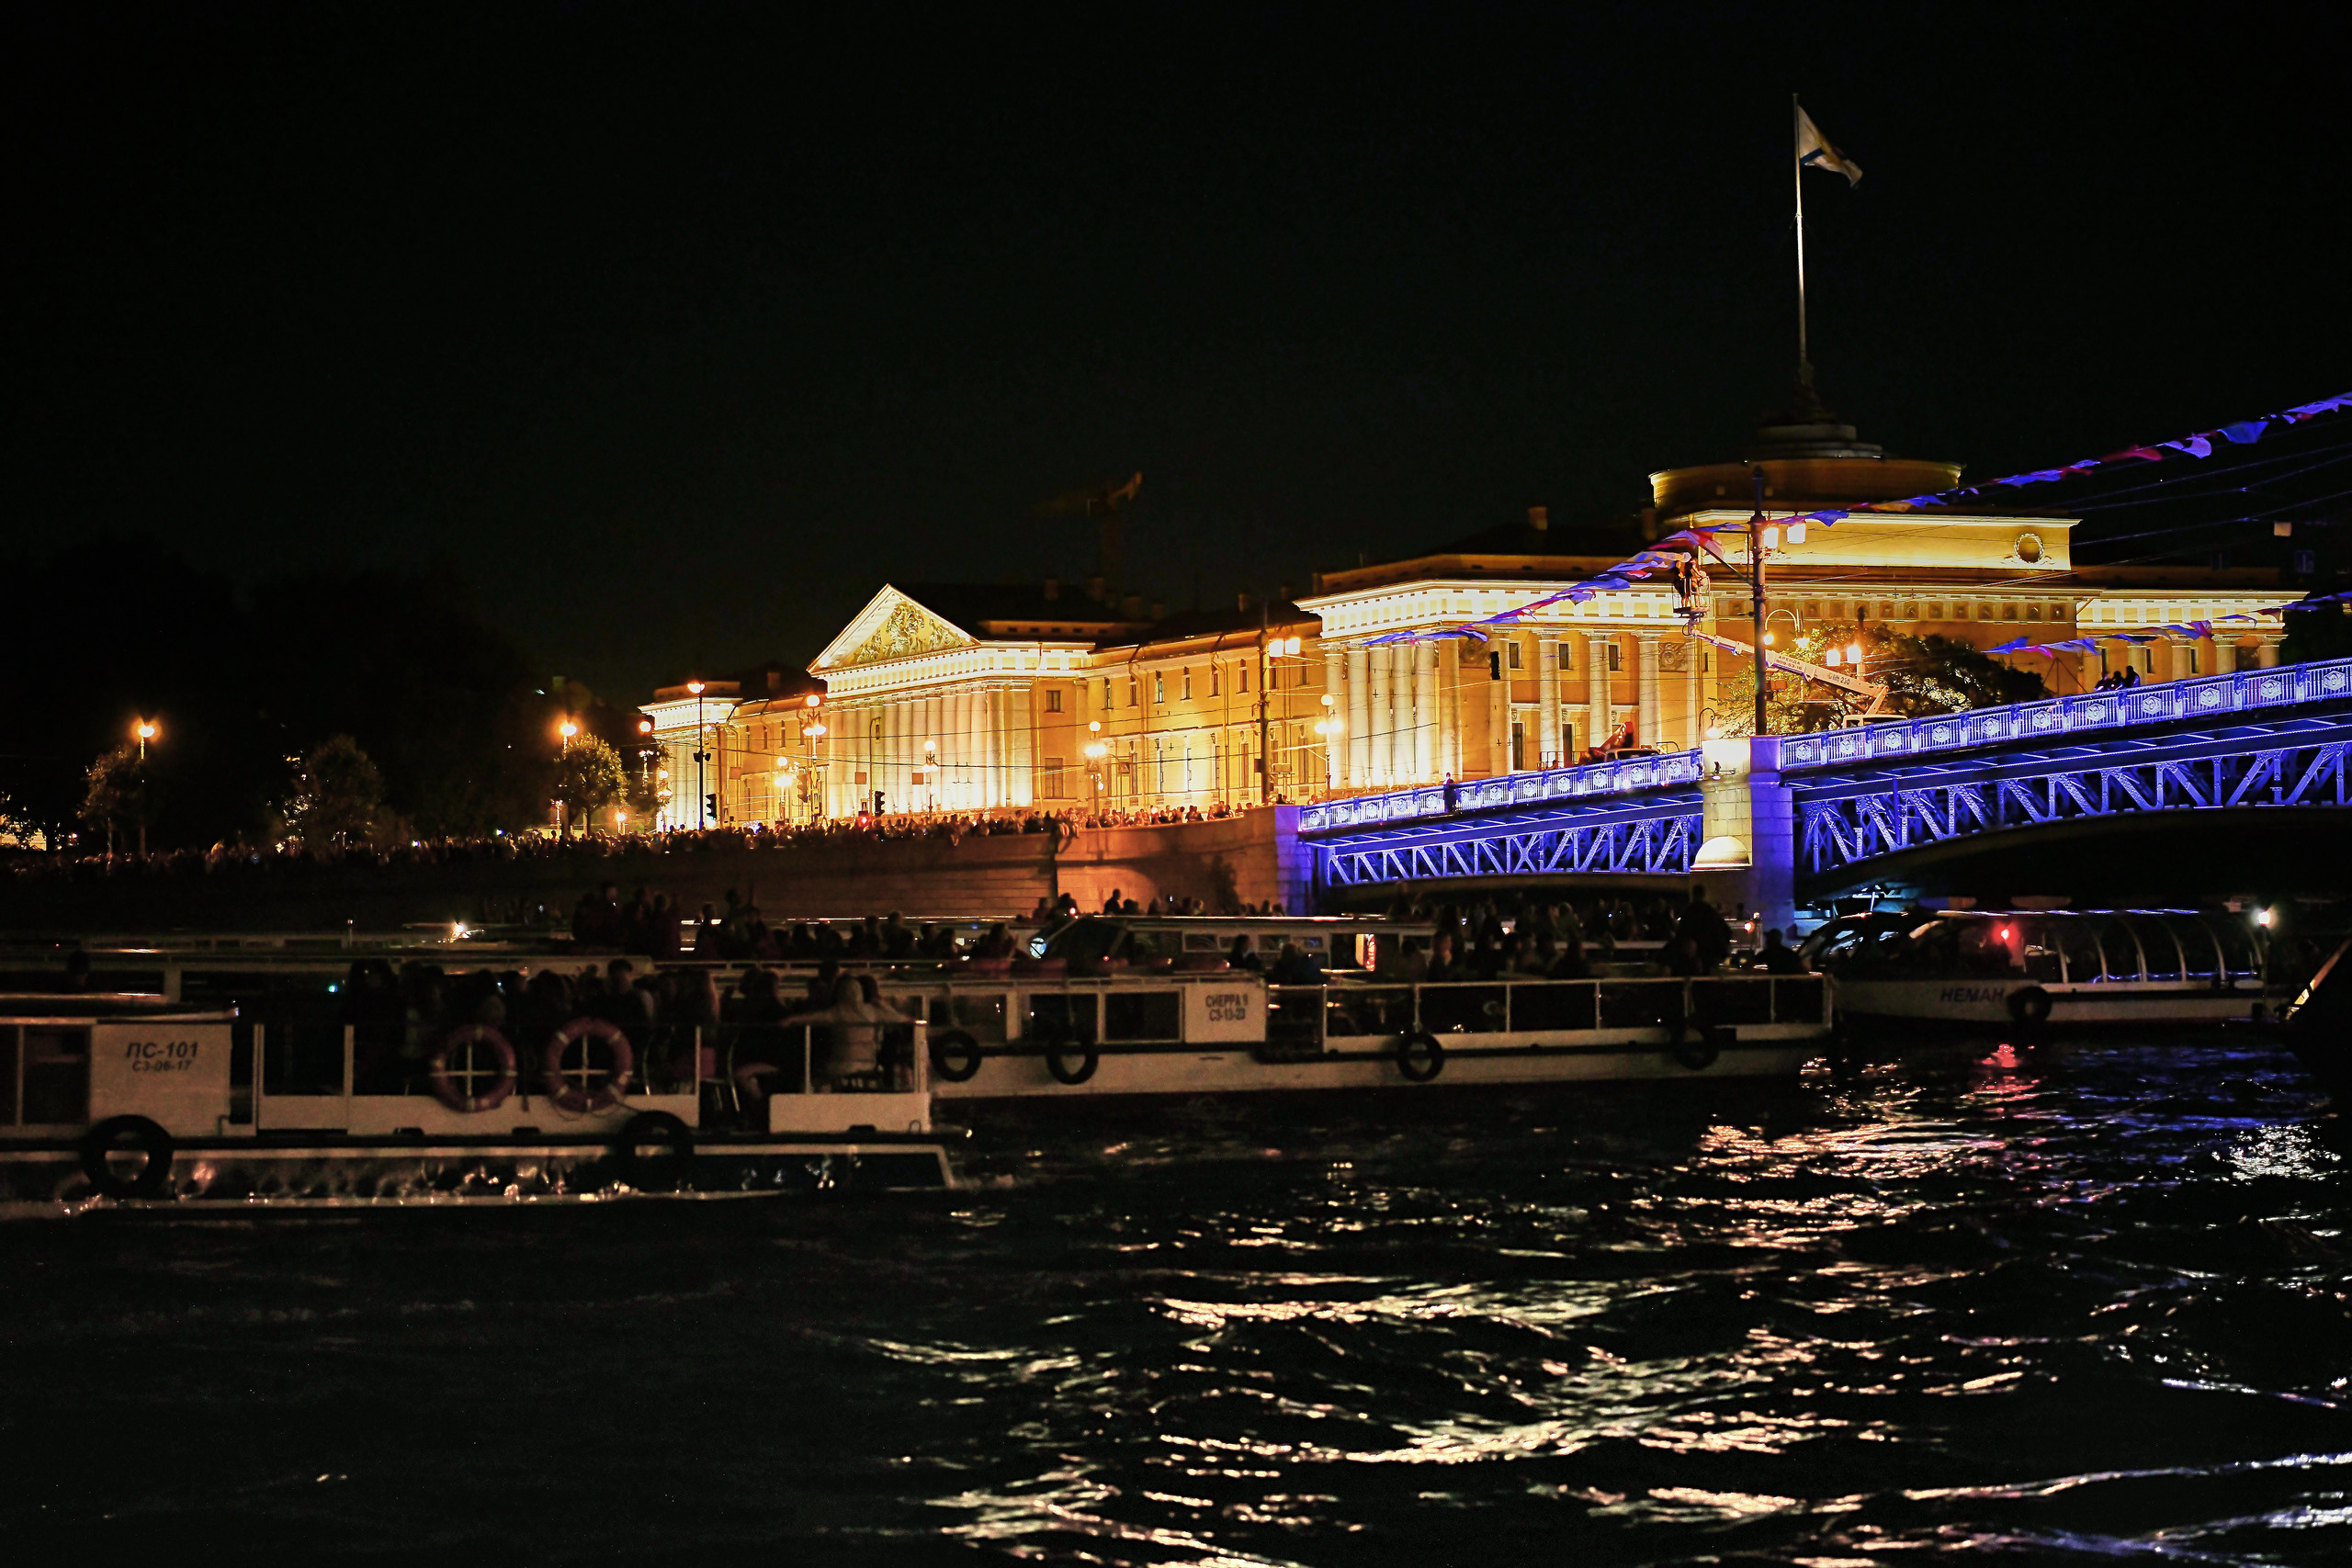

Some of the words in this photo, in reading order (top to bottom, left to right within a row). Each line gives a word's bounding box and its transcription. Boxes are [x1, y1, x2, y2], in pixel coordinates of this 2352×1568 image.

[1779, 655, 1801, 665] АРЕНДА
[1940, 987, 2004, 1002] НЕМАН
[126, 1042, 198, 1058] ПС-101
